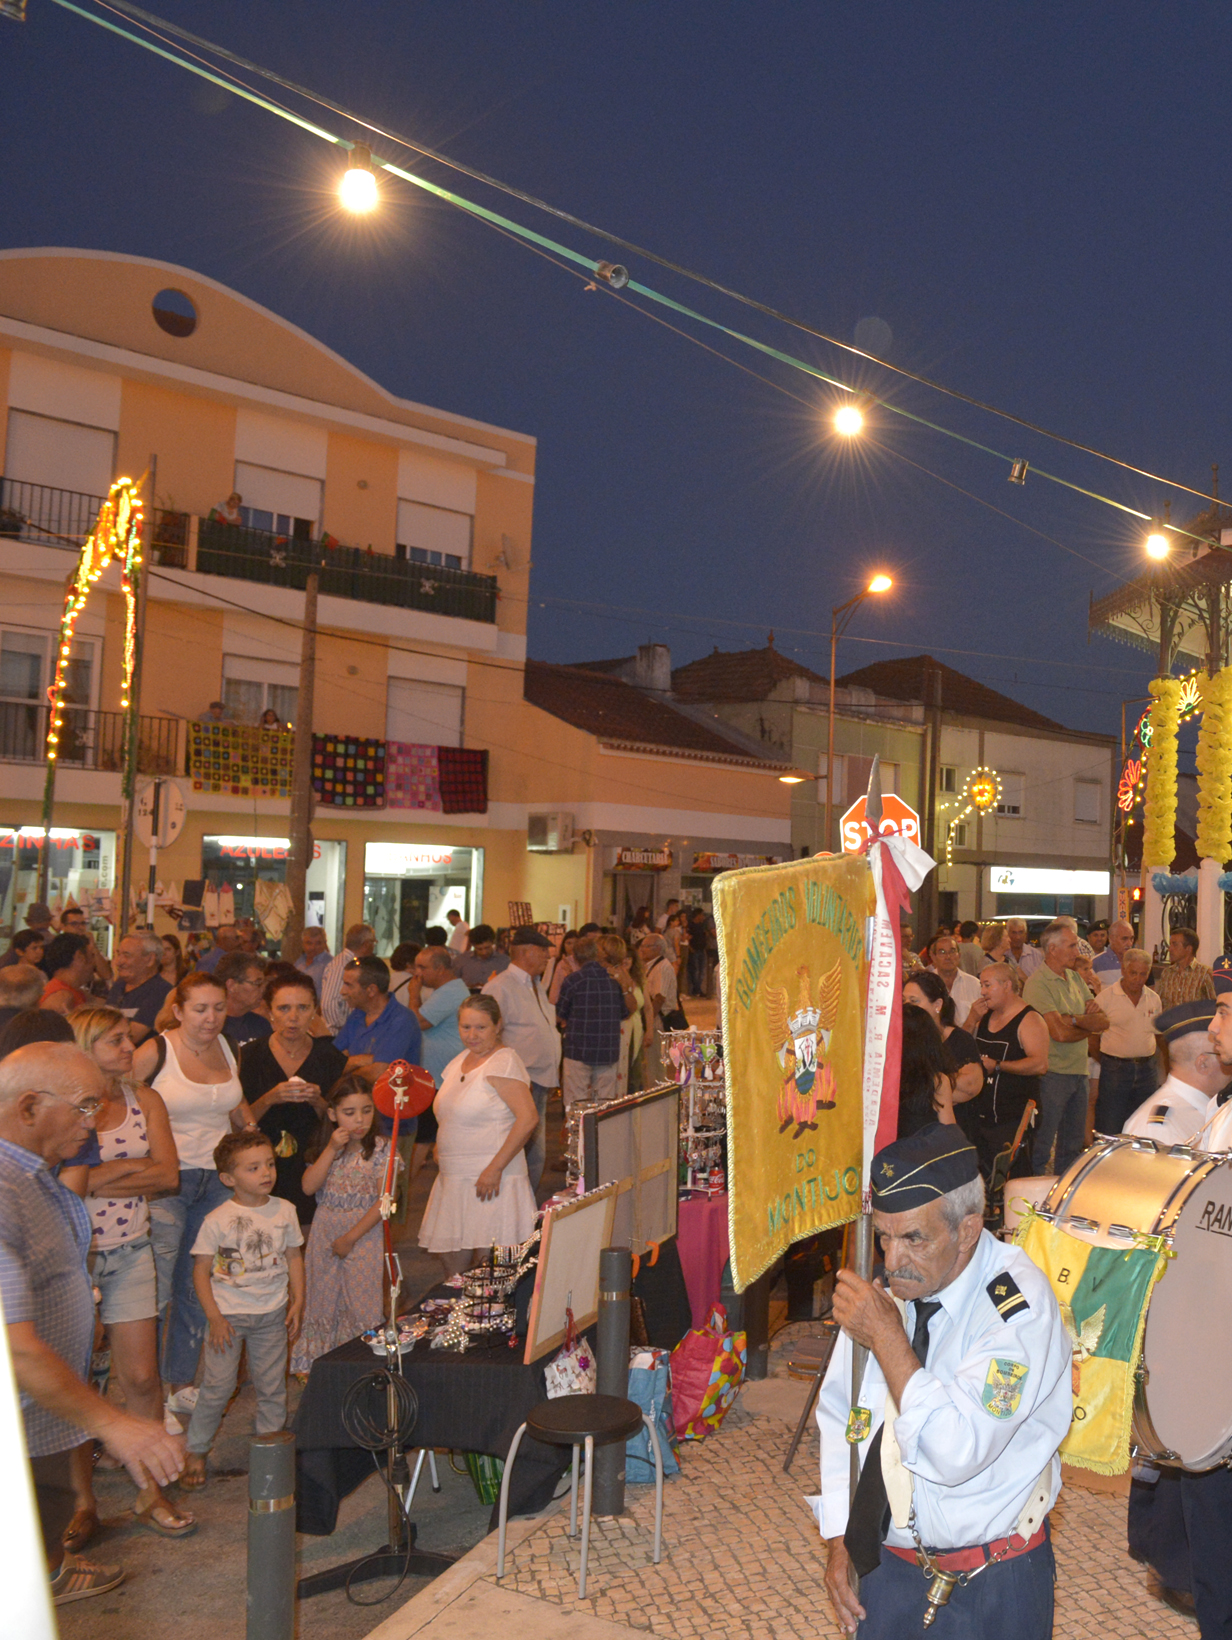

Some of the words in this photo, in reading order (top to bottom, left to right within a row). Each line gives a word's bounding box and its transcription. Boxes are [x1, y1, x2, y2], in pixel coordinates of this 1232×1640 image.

[219, 842, 322, 860] AZULES
[735, 886, 796, 1011] BOMBEIROS
[796, 1148, 816, 1174] DO
[767, 1166, 860, 1238] MONTIJO
